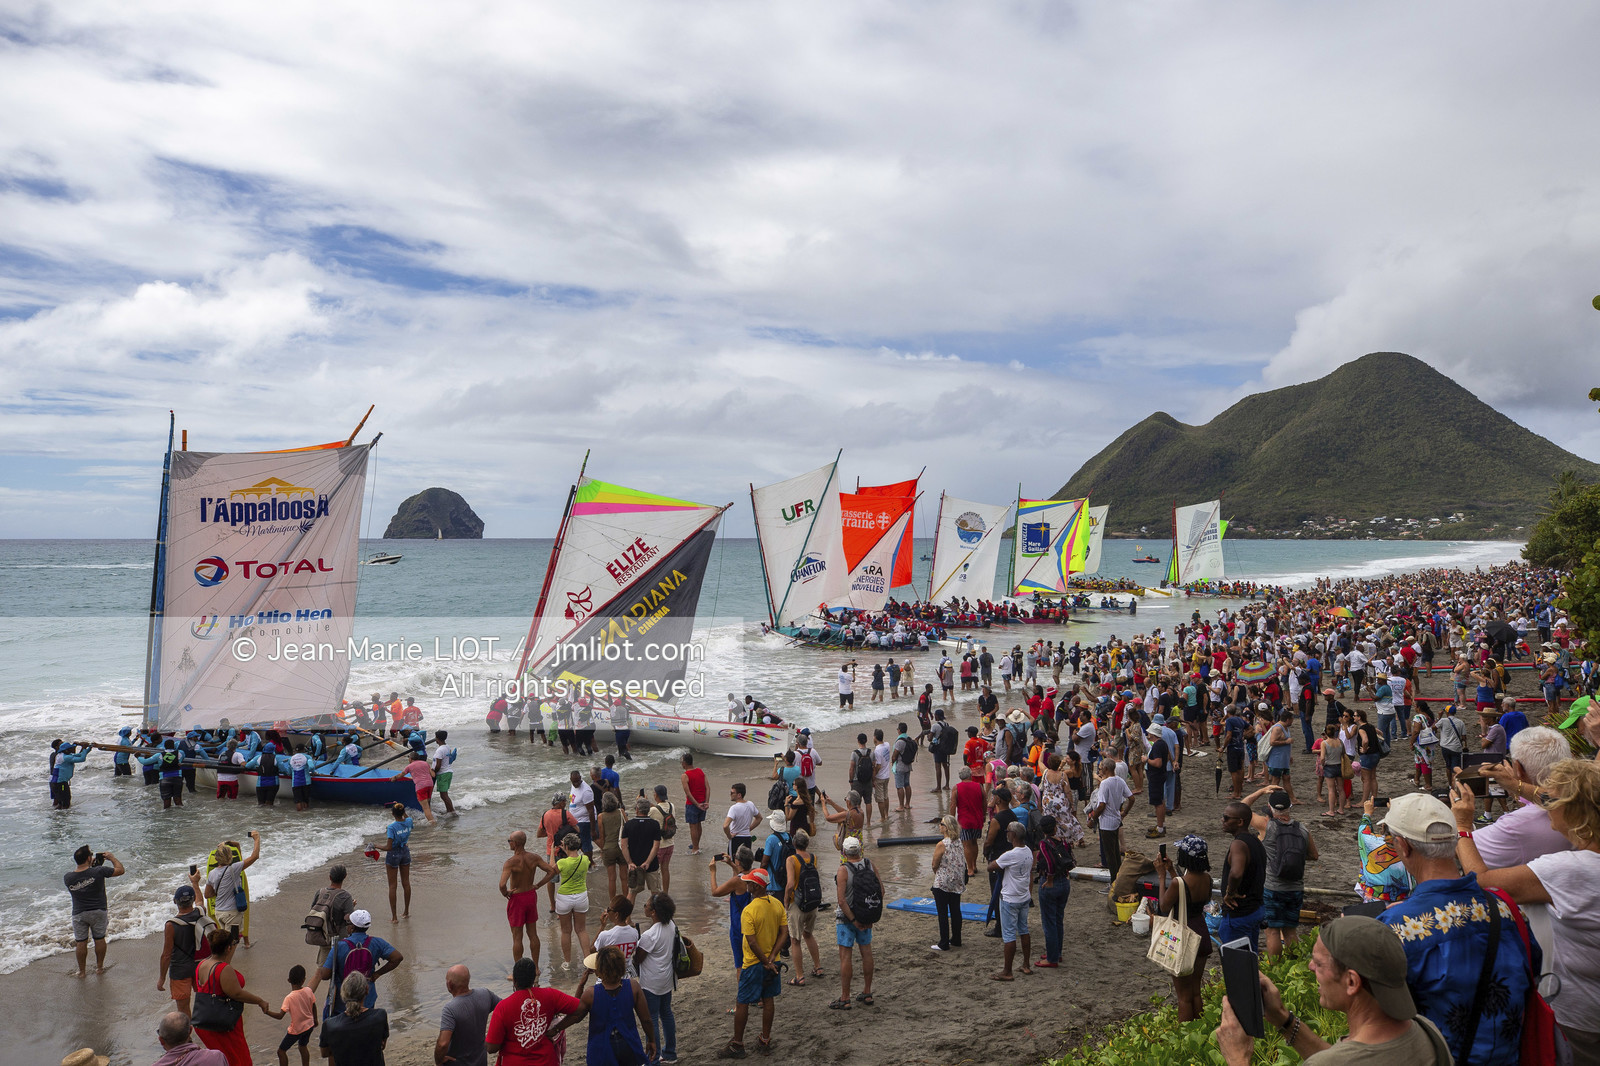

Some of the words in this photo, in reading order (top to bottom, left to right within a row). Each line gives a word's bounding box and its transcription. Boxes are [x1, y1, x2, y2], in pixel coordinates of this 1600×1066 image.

[781, 498, 816, 521] UFR
[840, 510, 874, 520] rasserie
[236, 524, 299, 537] Martinique
[840, 517, 876, 529] rraine
[605, 536, 651, 580] ÉLIZÉ
[616, 545, 661, 587] RESTAURANT
[235, 558, 334, 580] TOTAL
[790, 560, 827, 583] CHANFLOR
[851, 583, 884, 594] NOUVELLES
[854, 575, 886, 586] NERGIES
[228, 615, 254, 629] Ho
[257, 610, 292, 625] Hio
[295, 608, 333, 622] Hen
[600, 569, 688, 657] MADIANA
[637, 605, 671, 635] CINÉMA
[228, 624, 330, 641] Atomobile
